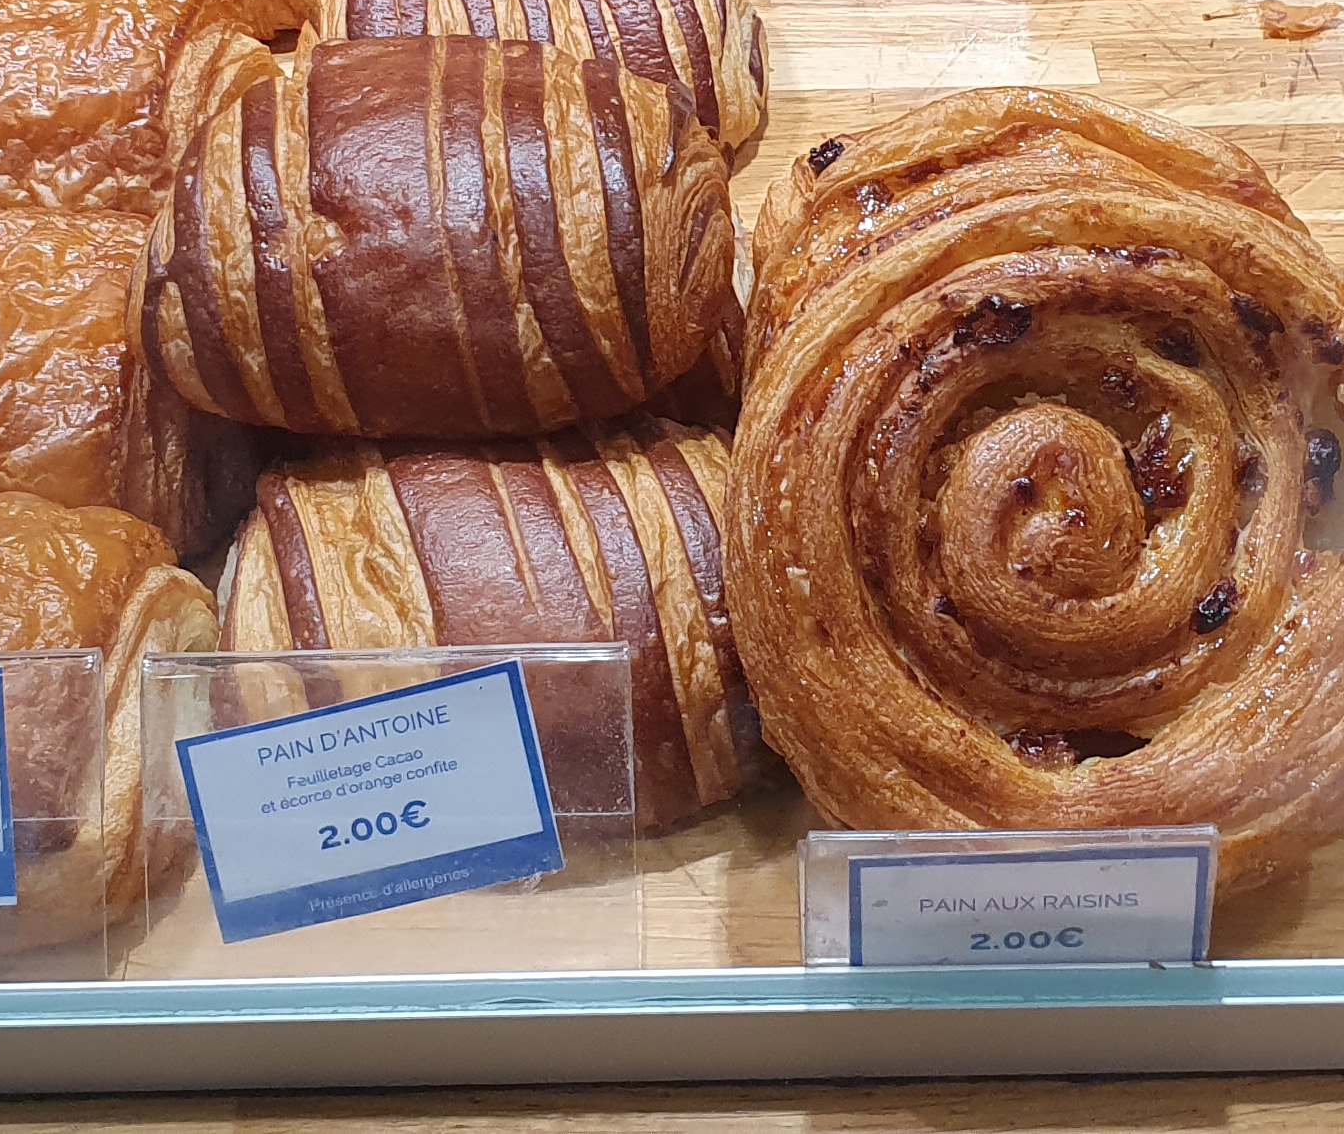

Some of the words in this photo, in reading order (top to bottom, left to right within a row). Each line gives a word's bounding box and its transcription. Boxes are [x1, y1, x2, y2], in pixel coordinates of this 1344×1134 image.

[256, 736, 315, 767] PAIN
[321, 703, 452, 753] D'ANTOINE
[260, 800, 277, 815] et
[279, 788, 333, 809] écorce
[335, 771, 404, 797] d'orange
[406, 758, 459, 781] confite
[286, 760, 373, 789] Feuilletage
[374, 747, 425, 769] Cacao
[317, 799, 432, 851] 2.00€
[919, 897, 977, 914] PAIN
[983, 895, 1036, 912] AUX
[1043, 891, 1140, 910] RAISINS
[969, 926, 1085, 951] 2.00€
